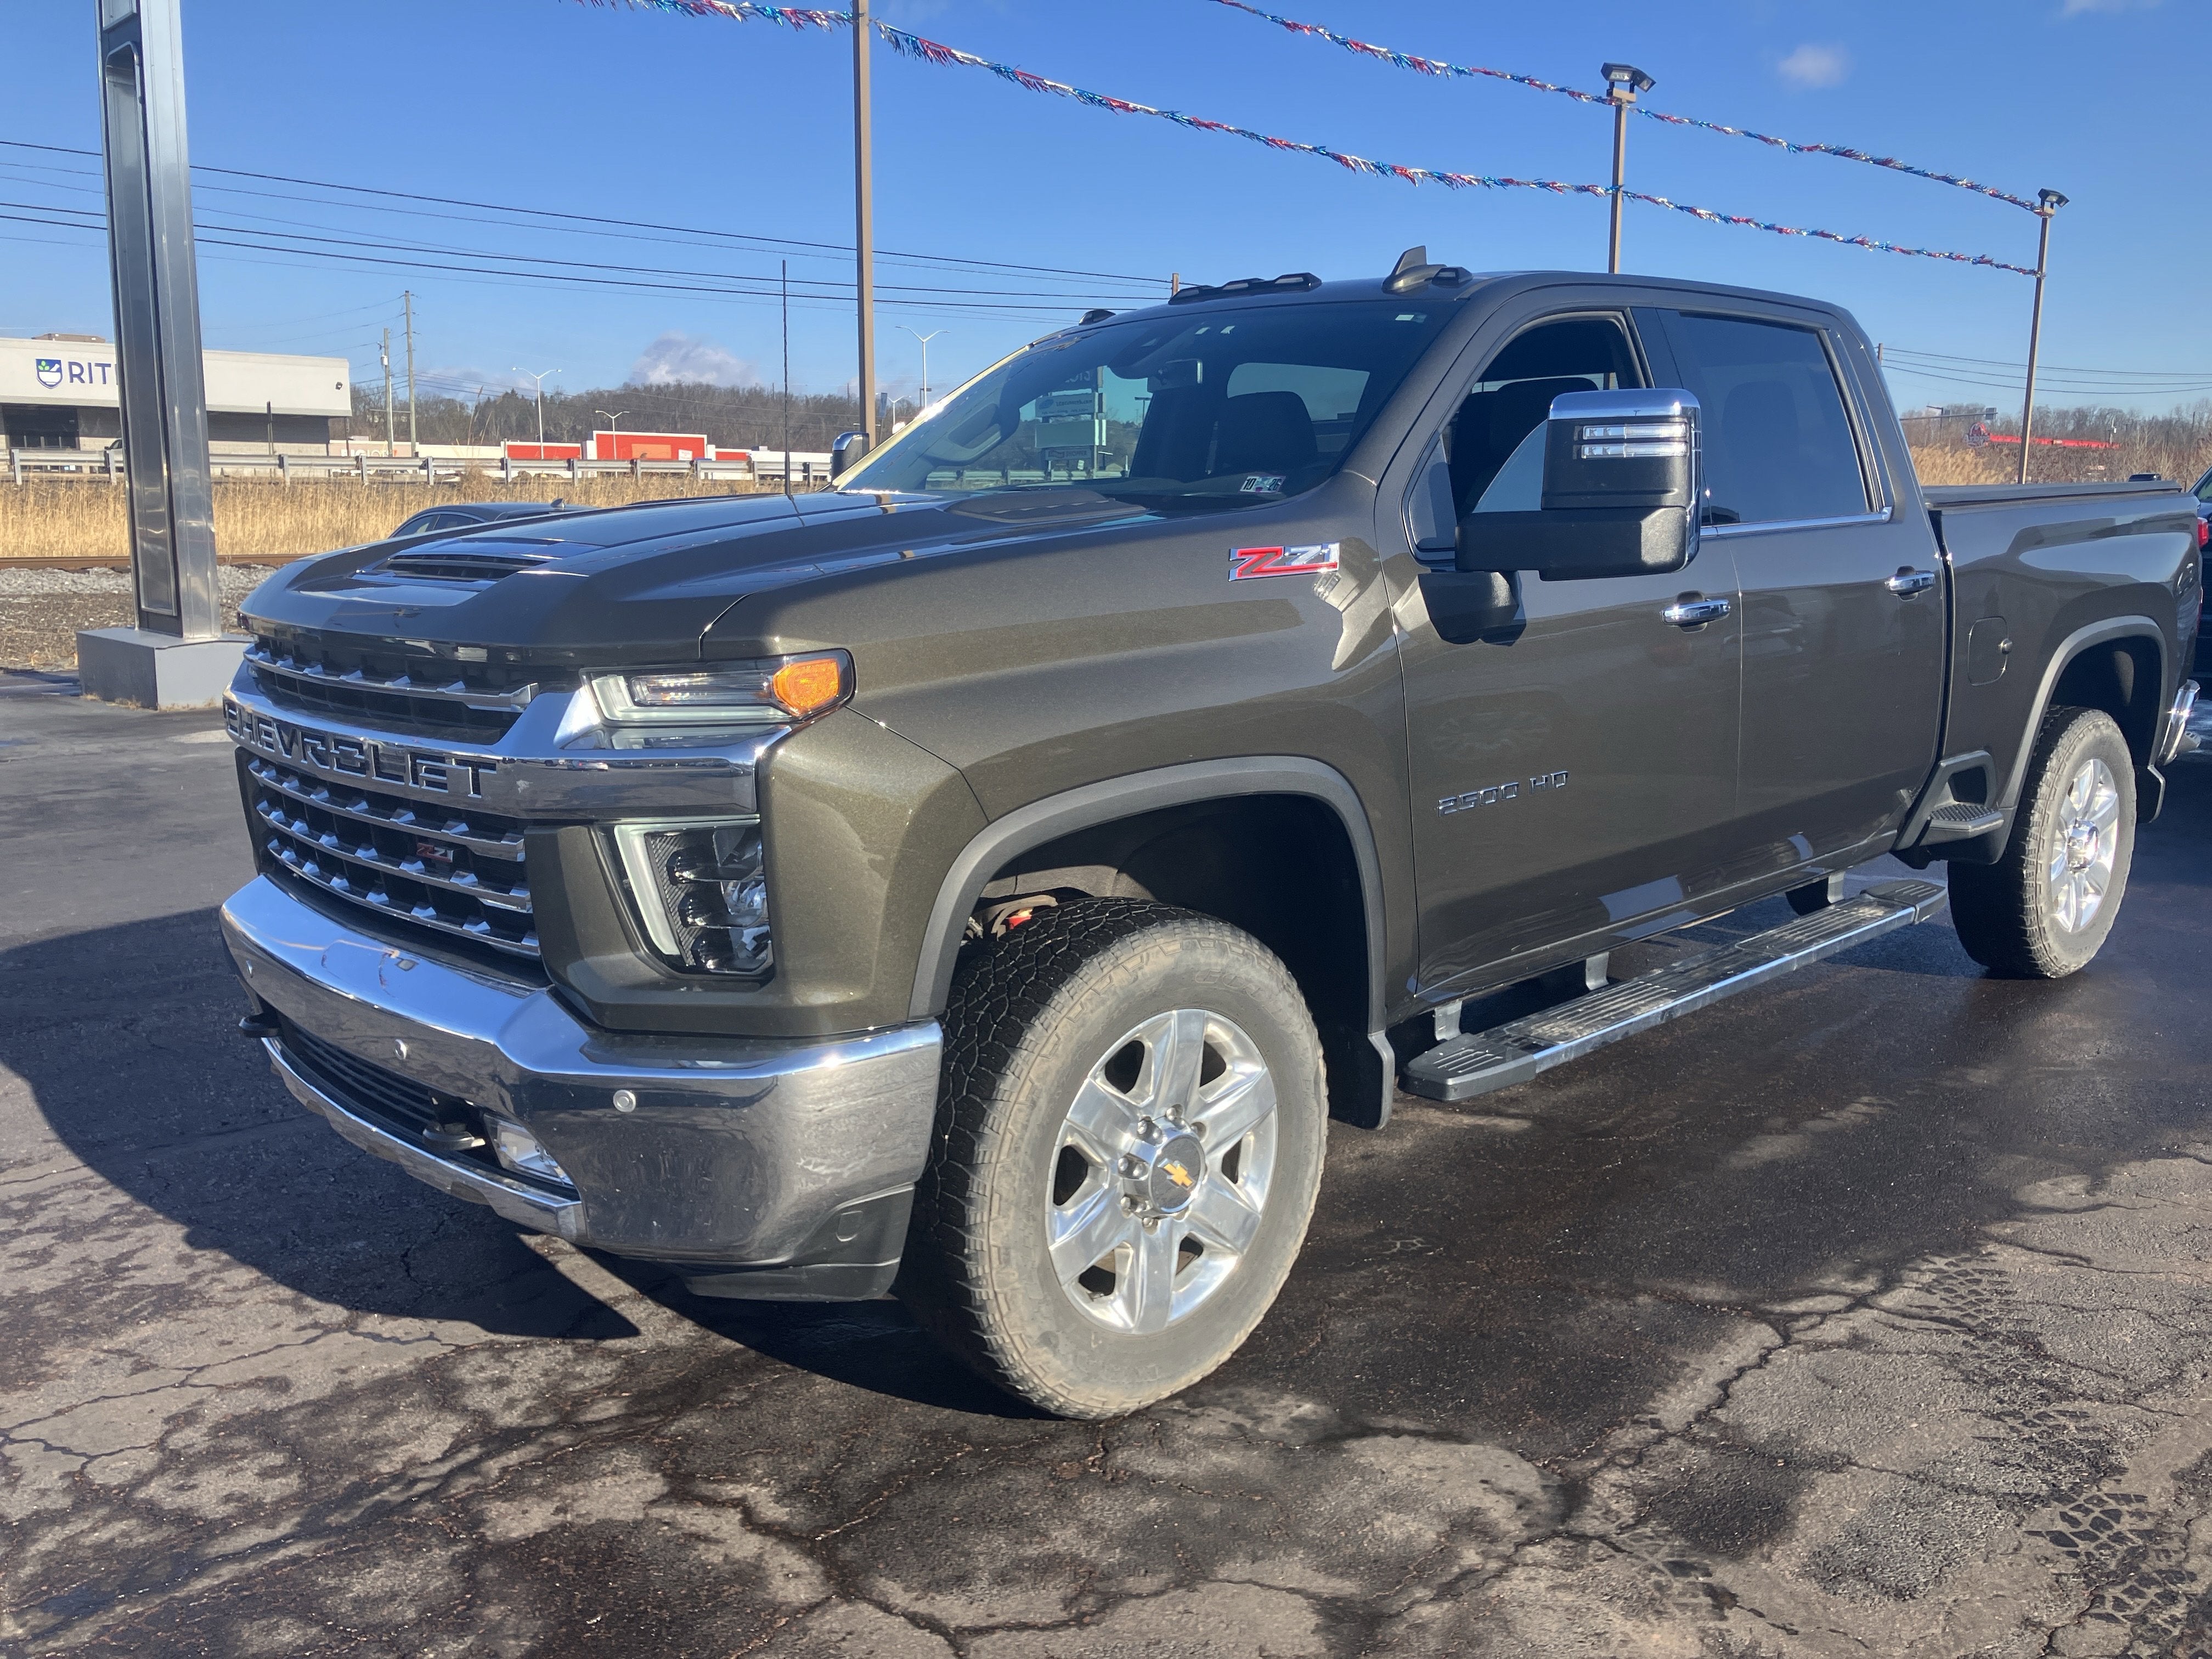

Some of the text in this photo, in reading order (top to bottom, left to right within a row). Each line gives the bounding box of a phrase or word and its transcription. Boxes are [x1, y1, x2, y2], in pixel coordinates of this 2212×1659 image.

[68, 362, 117, 385] RIT
[1228, 542, 1340, 582] Z71
[223, 699, 498, 799] CHEVROLET
[1436, 770, 1568, 817] 2500 HD
[416, 842, 454, 864] Z71
